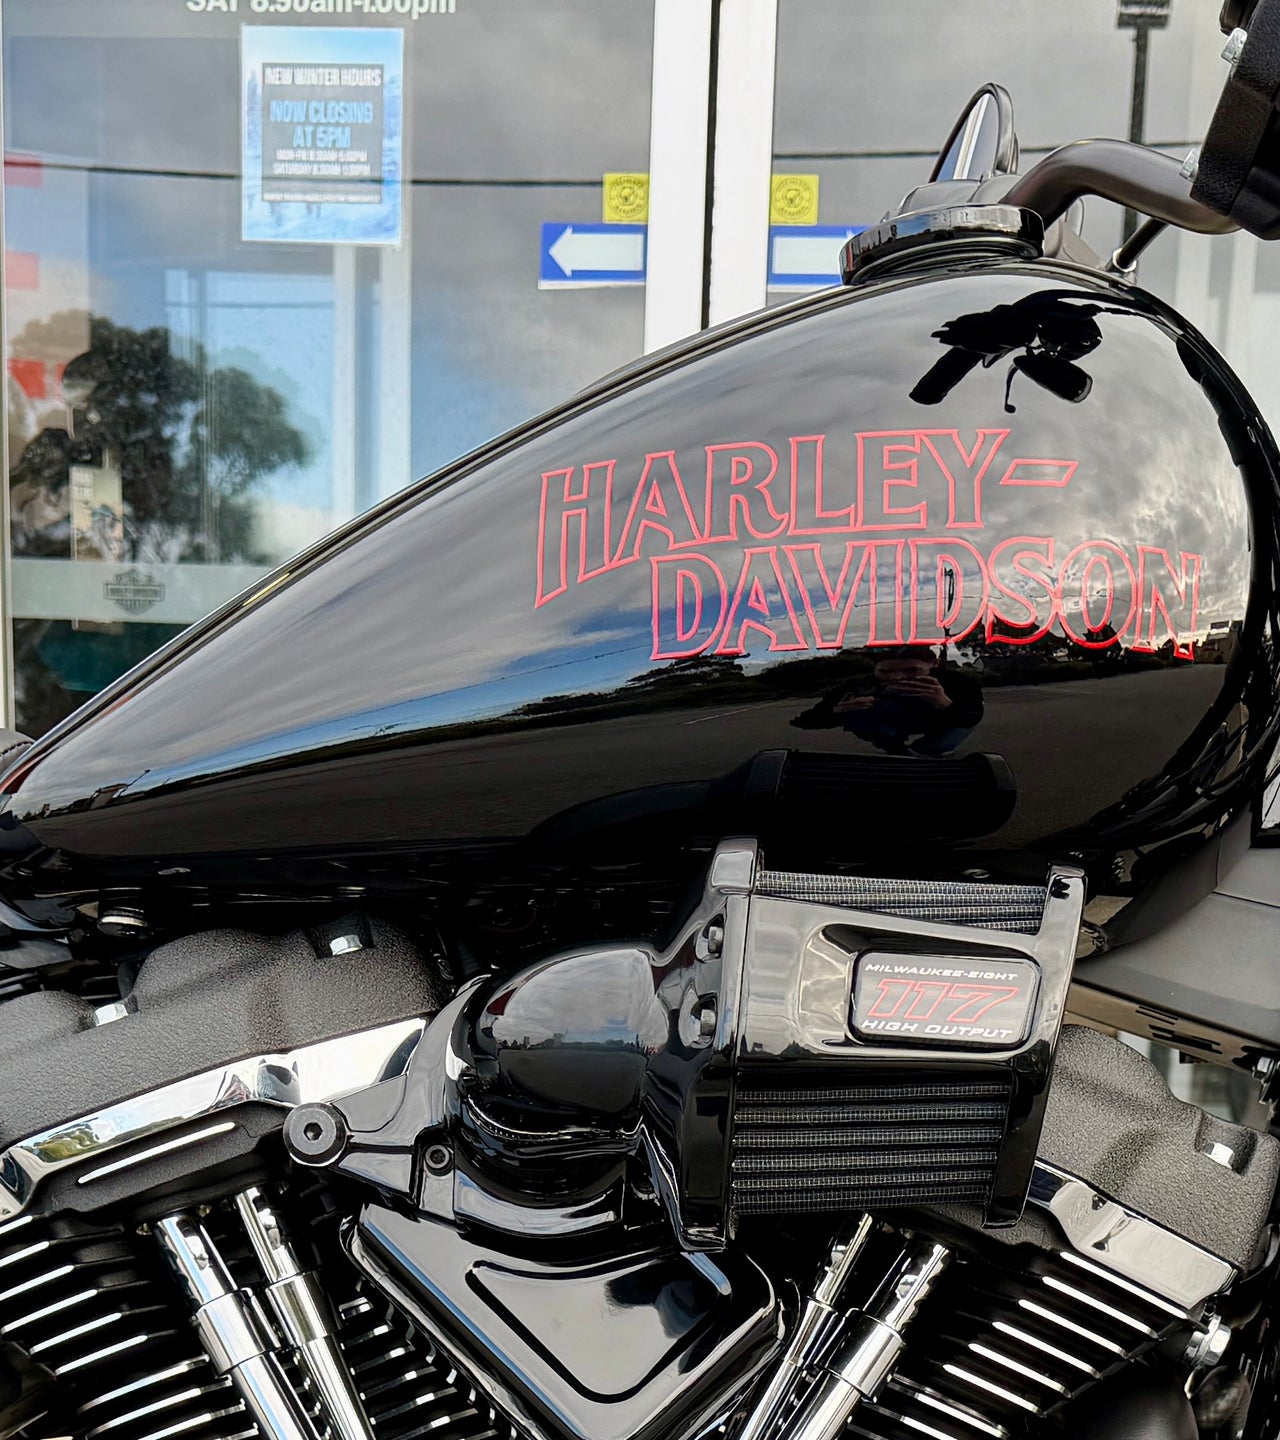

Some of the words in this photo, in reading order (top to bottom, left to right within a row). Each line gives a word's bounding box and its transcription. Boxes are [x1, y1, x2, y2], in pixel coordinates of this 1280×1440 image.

[265, 67, 292, 85] NEW
[294, 67, 340, 86] WINTER
[341, 68, 382, 87] HOURS
[270, 100, 307, 122] NOW
[309, 100, 374, 124] CLOSING
[293, 125, 313, 147] AT
[317, 126, 352, 148] 5PM
[649, 537, 1201, 661] DAVIDSON
[865, 963, 1018, 981] MILWAUKEE-EIGHT
[868, 978, 1020, 1024] 117
[861, 1019, 918, 1033] HIGH
[924, 1023, 1013, 1039] OUTPUT
